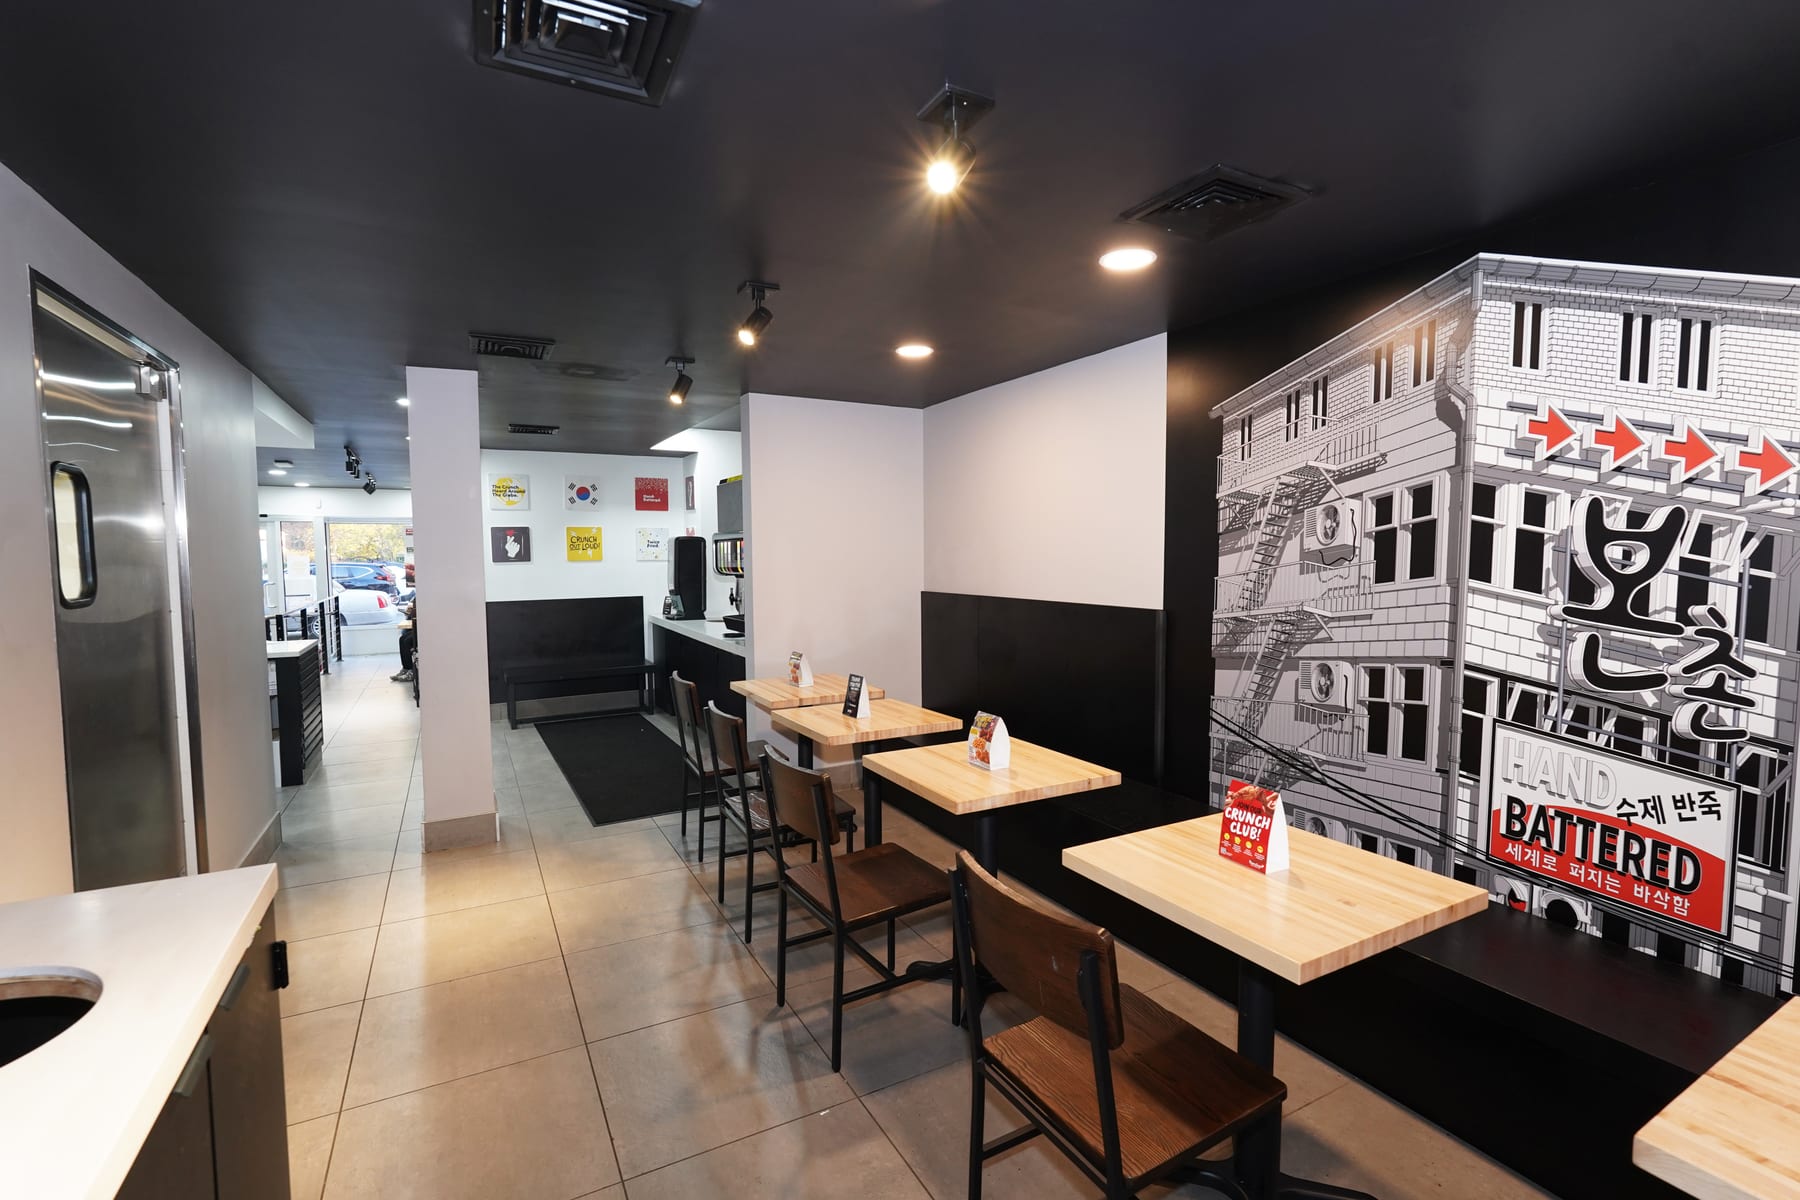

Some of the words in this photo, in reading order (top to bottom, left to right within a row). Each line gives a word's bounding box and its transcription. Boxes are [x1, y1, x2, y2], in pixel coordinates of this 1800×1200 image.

[570, 535, 597, 543] CRUNCH
[1501, 737, 1617, 809] HAND
[1225, 806, 1271, 830] CRUNCH
[1616, 793, 1667, 827] 수제
[1671, 789, 1722, 823] 반죽
[1230, 821, 1262, 842] CLUB!
[1499, 793, 1703, 895] BATTERED
[1504, 841, 1558, 873] 세계로
[1569, 861, 1622, 894] 퍼지는
[1633, 883, 1691, 917] 바삭함
